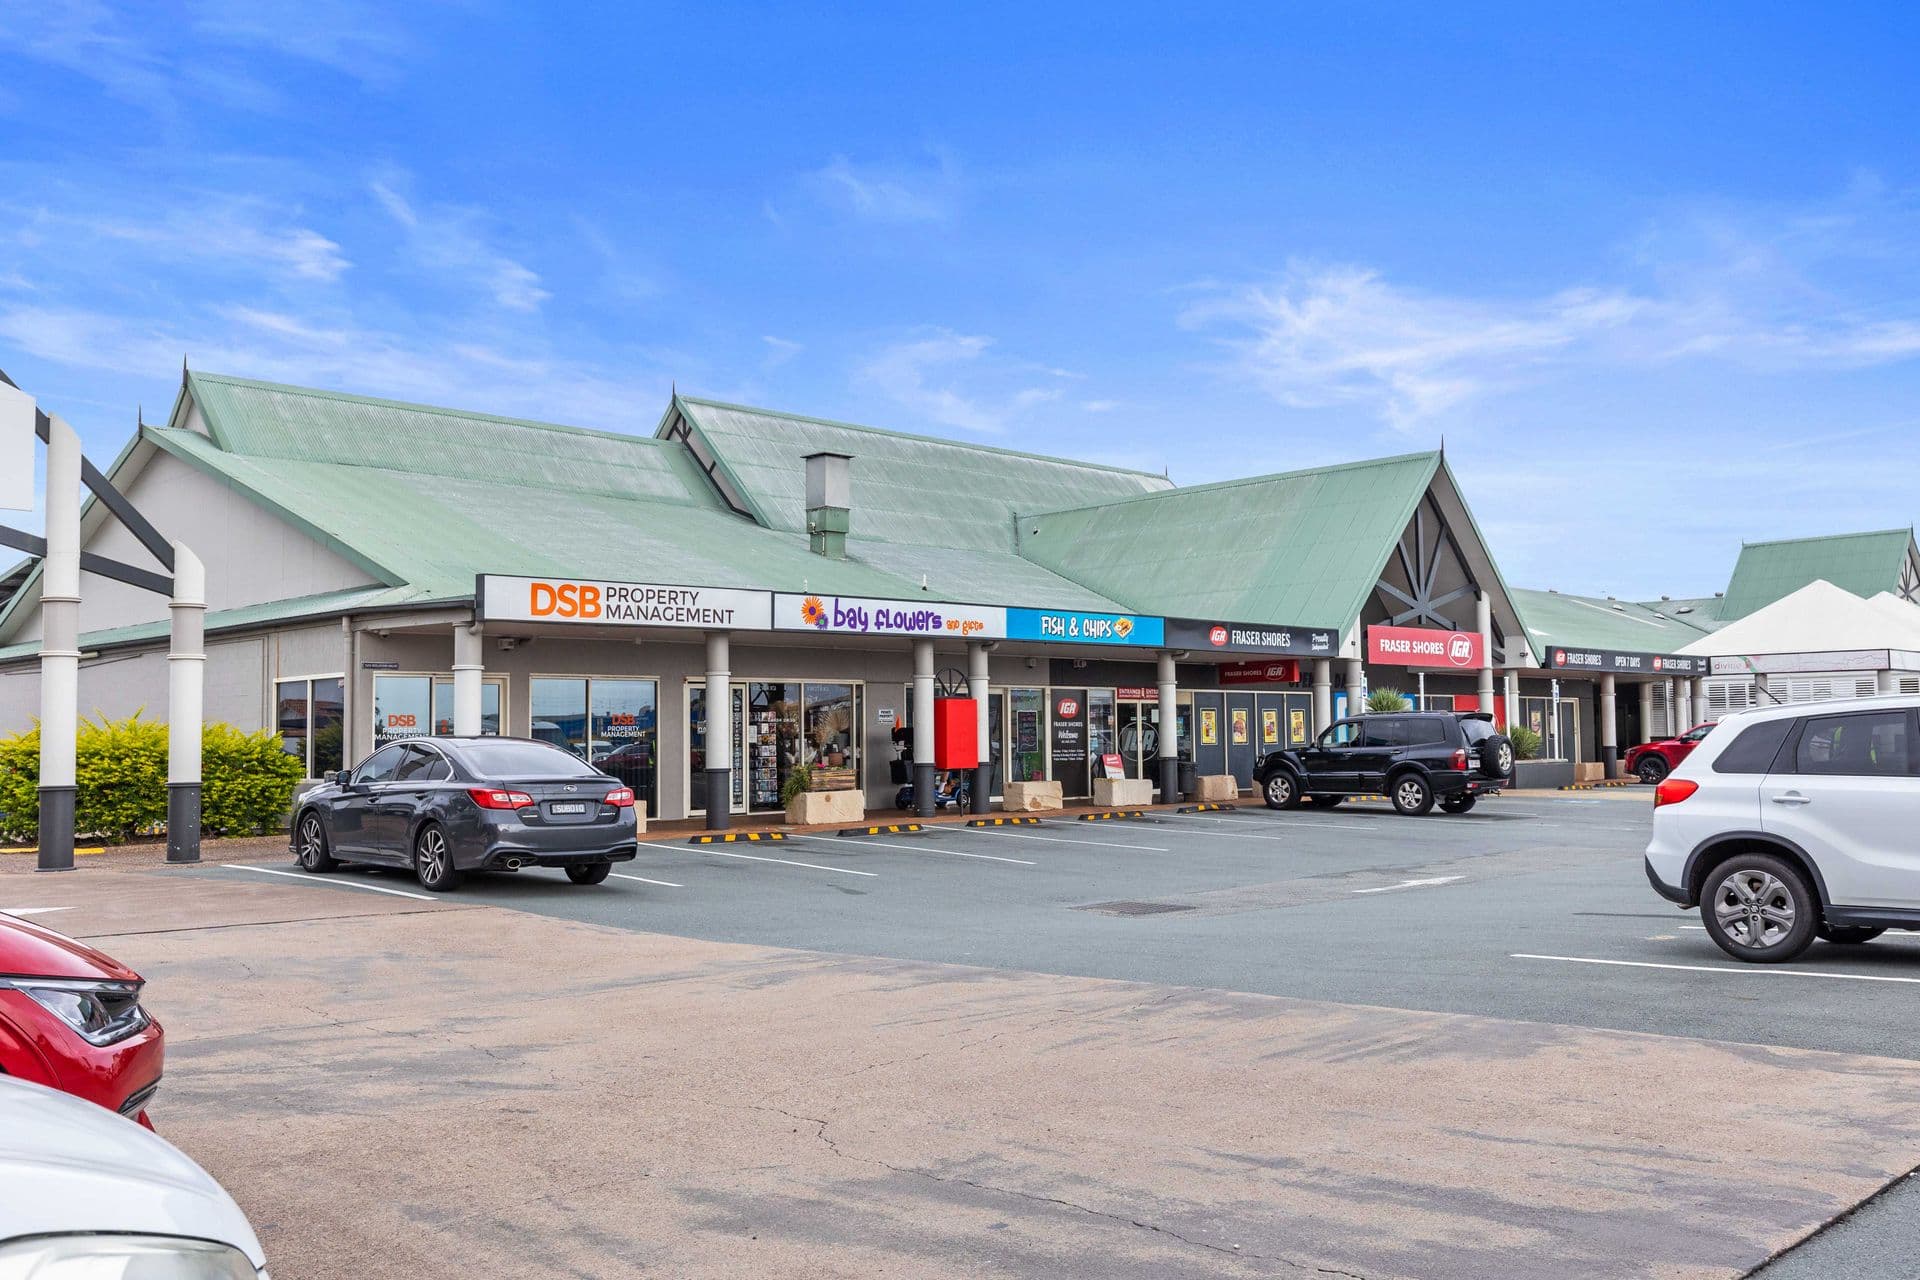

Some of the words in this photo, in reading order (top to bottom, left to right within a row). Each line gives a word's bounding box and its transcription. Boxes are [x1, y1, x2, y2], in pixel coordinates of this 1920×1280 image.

[530, 583, 601, 618] DSB
[606, 586, 700, 606] PROPERTY
[606, 604, 735, 624] MANAGEMENT
[833, 597, 869, 632] bay
[1041, 616, 1066, 637] FISH
[1069, 618, 1080, 637] &
[1083, 618, 1112, 639] CHIPS
[1211, 630, 1226, 642] IGA
[1231, 630, 1261, 646] FRASER
[1262, 632, 1291, 648] SHORES
[1380, 639, 1411, 653] FRASER
[1413, 641, 1444, 655] SHORES
[1451, 640, 1470, 658] IGA
[1567, 653, 1585, 665] FRASER
[1585, 654, 1602, 666] SHORES
[1615, 656, 1626, 667] OPEN
[1630, 657, 1641, 668] DAYS
[1267, 666, 1284, 677] IGA
[1060, 702, 1076, 714] IGA
[388, 714, 416, 727] DSB
[611, 713, 635, 725] DSB
